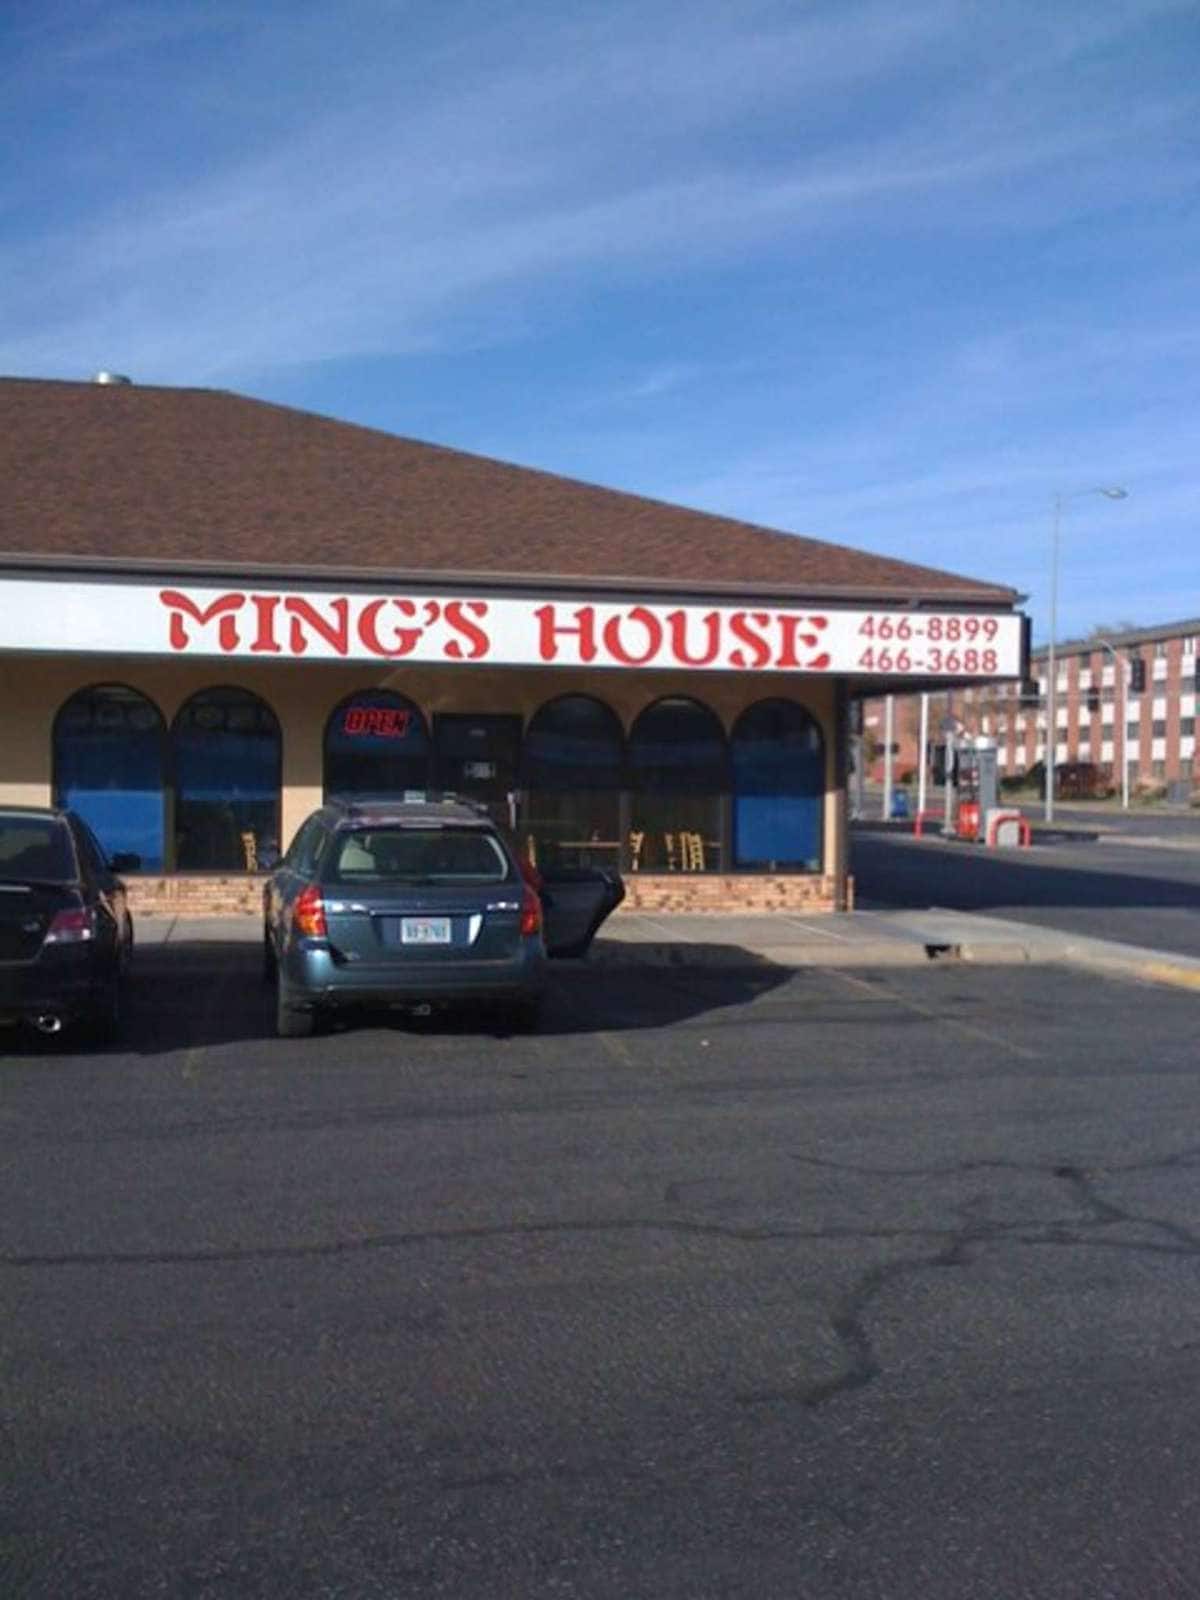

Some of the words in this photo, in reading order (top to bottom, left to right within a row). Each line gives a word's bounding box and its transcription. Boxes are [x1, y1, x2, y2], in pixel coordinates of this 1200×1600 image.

[159, 589, 489, 659] MING'S
[535, 603, 830, 669] HOUSE
[858, 614, 998, 642] 466-8899
[858, 647, 997, 674] 466-3688
[344, 708, 410, 737] OPEN
